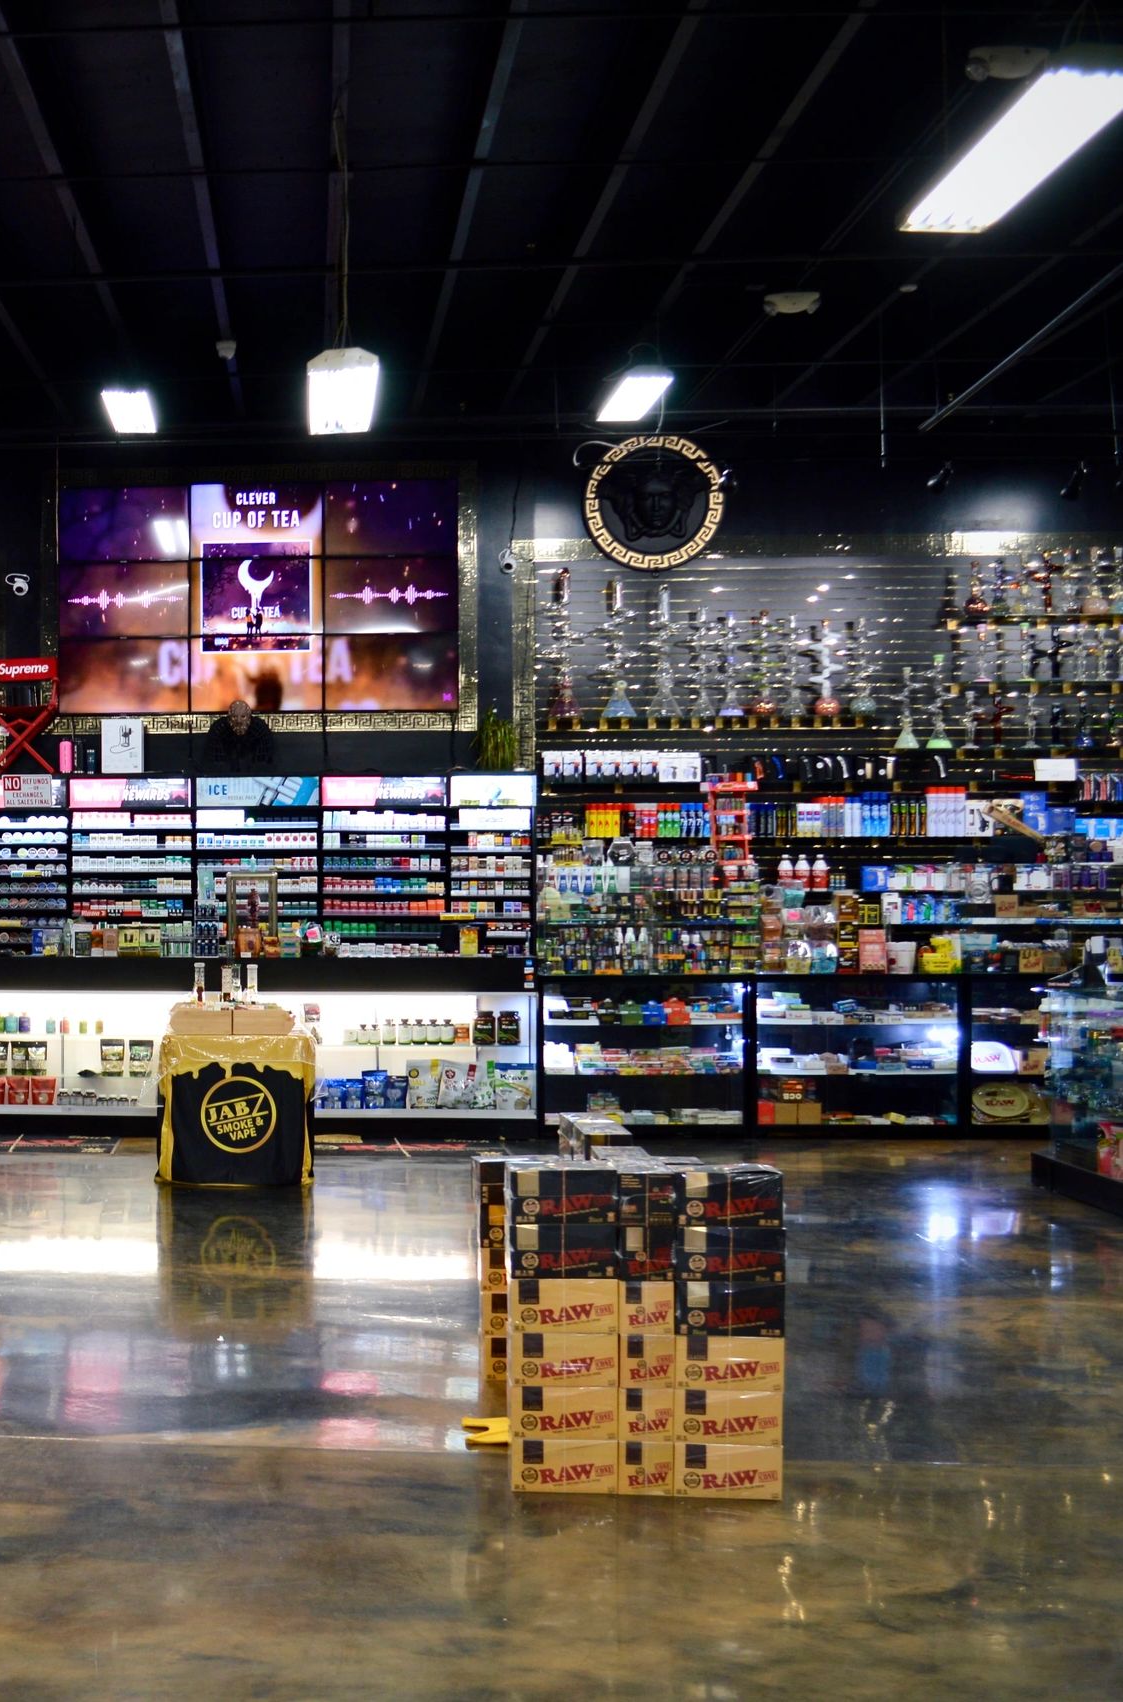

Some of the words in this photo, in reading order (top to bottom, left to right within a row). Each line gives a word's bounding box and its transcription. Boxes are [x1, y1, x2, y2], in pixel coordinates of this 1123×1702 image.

[236, 492, 275, 505] CLEVER
[213, 512, 242, 528] CUP
[247, 511, 265, 528] OF
[271, 510, 300, 527] TEA
[4, 777, 20, 790] NO
[208, 785, 227, 796] ICE
[207, 1093, 269, 1123] JABZ
[216, 1120, 254, 1135] SMOKE
[255, 1116, 264, 1127] &
[229, 1127, 257, 1142] VAPE
[540, 1194, 594, 1216] RAW
[704, 1197, 758, 1217] RAW
[540, 1248, 592, 1270] RAW
[706, 1251, 761, 1272] RAW
[538, 1303, 594, 1324] RAW
[628, 1311, 669, 1326] RAW
[539, 1357, 594, 1378] RAW
[629, 1364, 670, 1380] RAW
[703, 1361, 760, 1382] RAW
[539, 1410, 595, 1431] RAW
[628, 1418, 669, 1433] RAW
[702, 1415, 758, 1436] RAW
[539, 1463, 595, 1485] RAW
[628, 1472, 669, 1487] RAW
[702, 1469, 758, 1489] RAW
